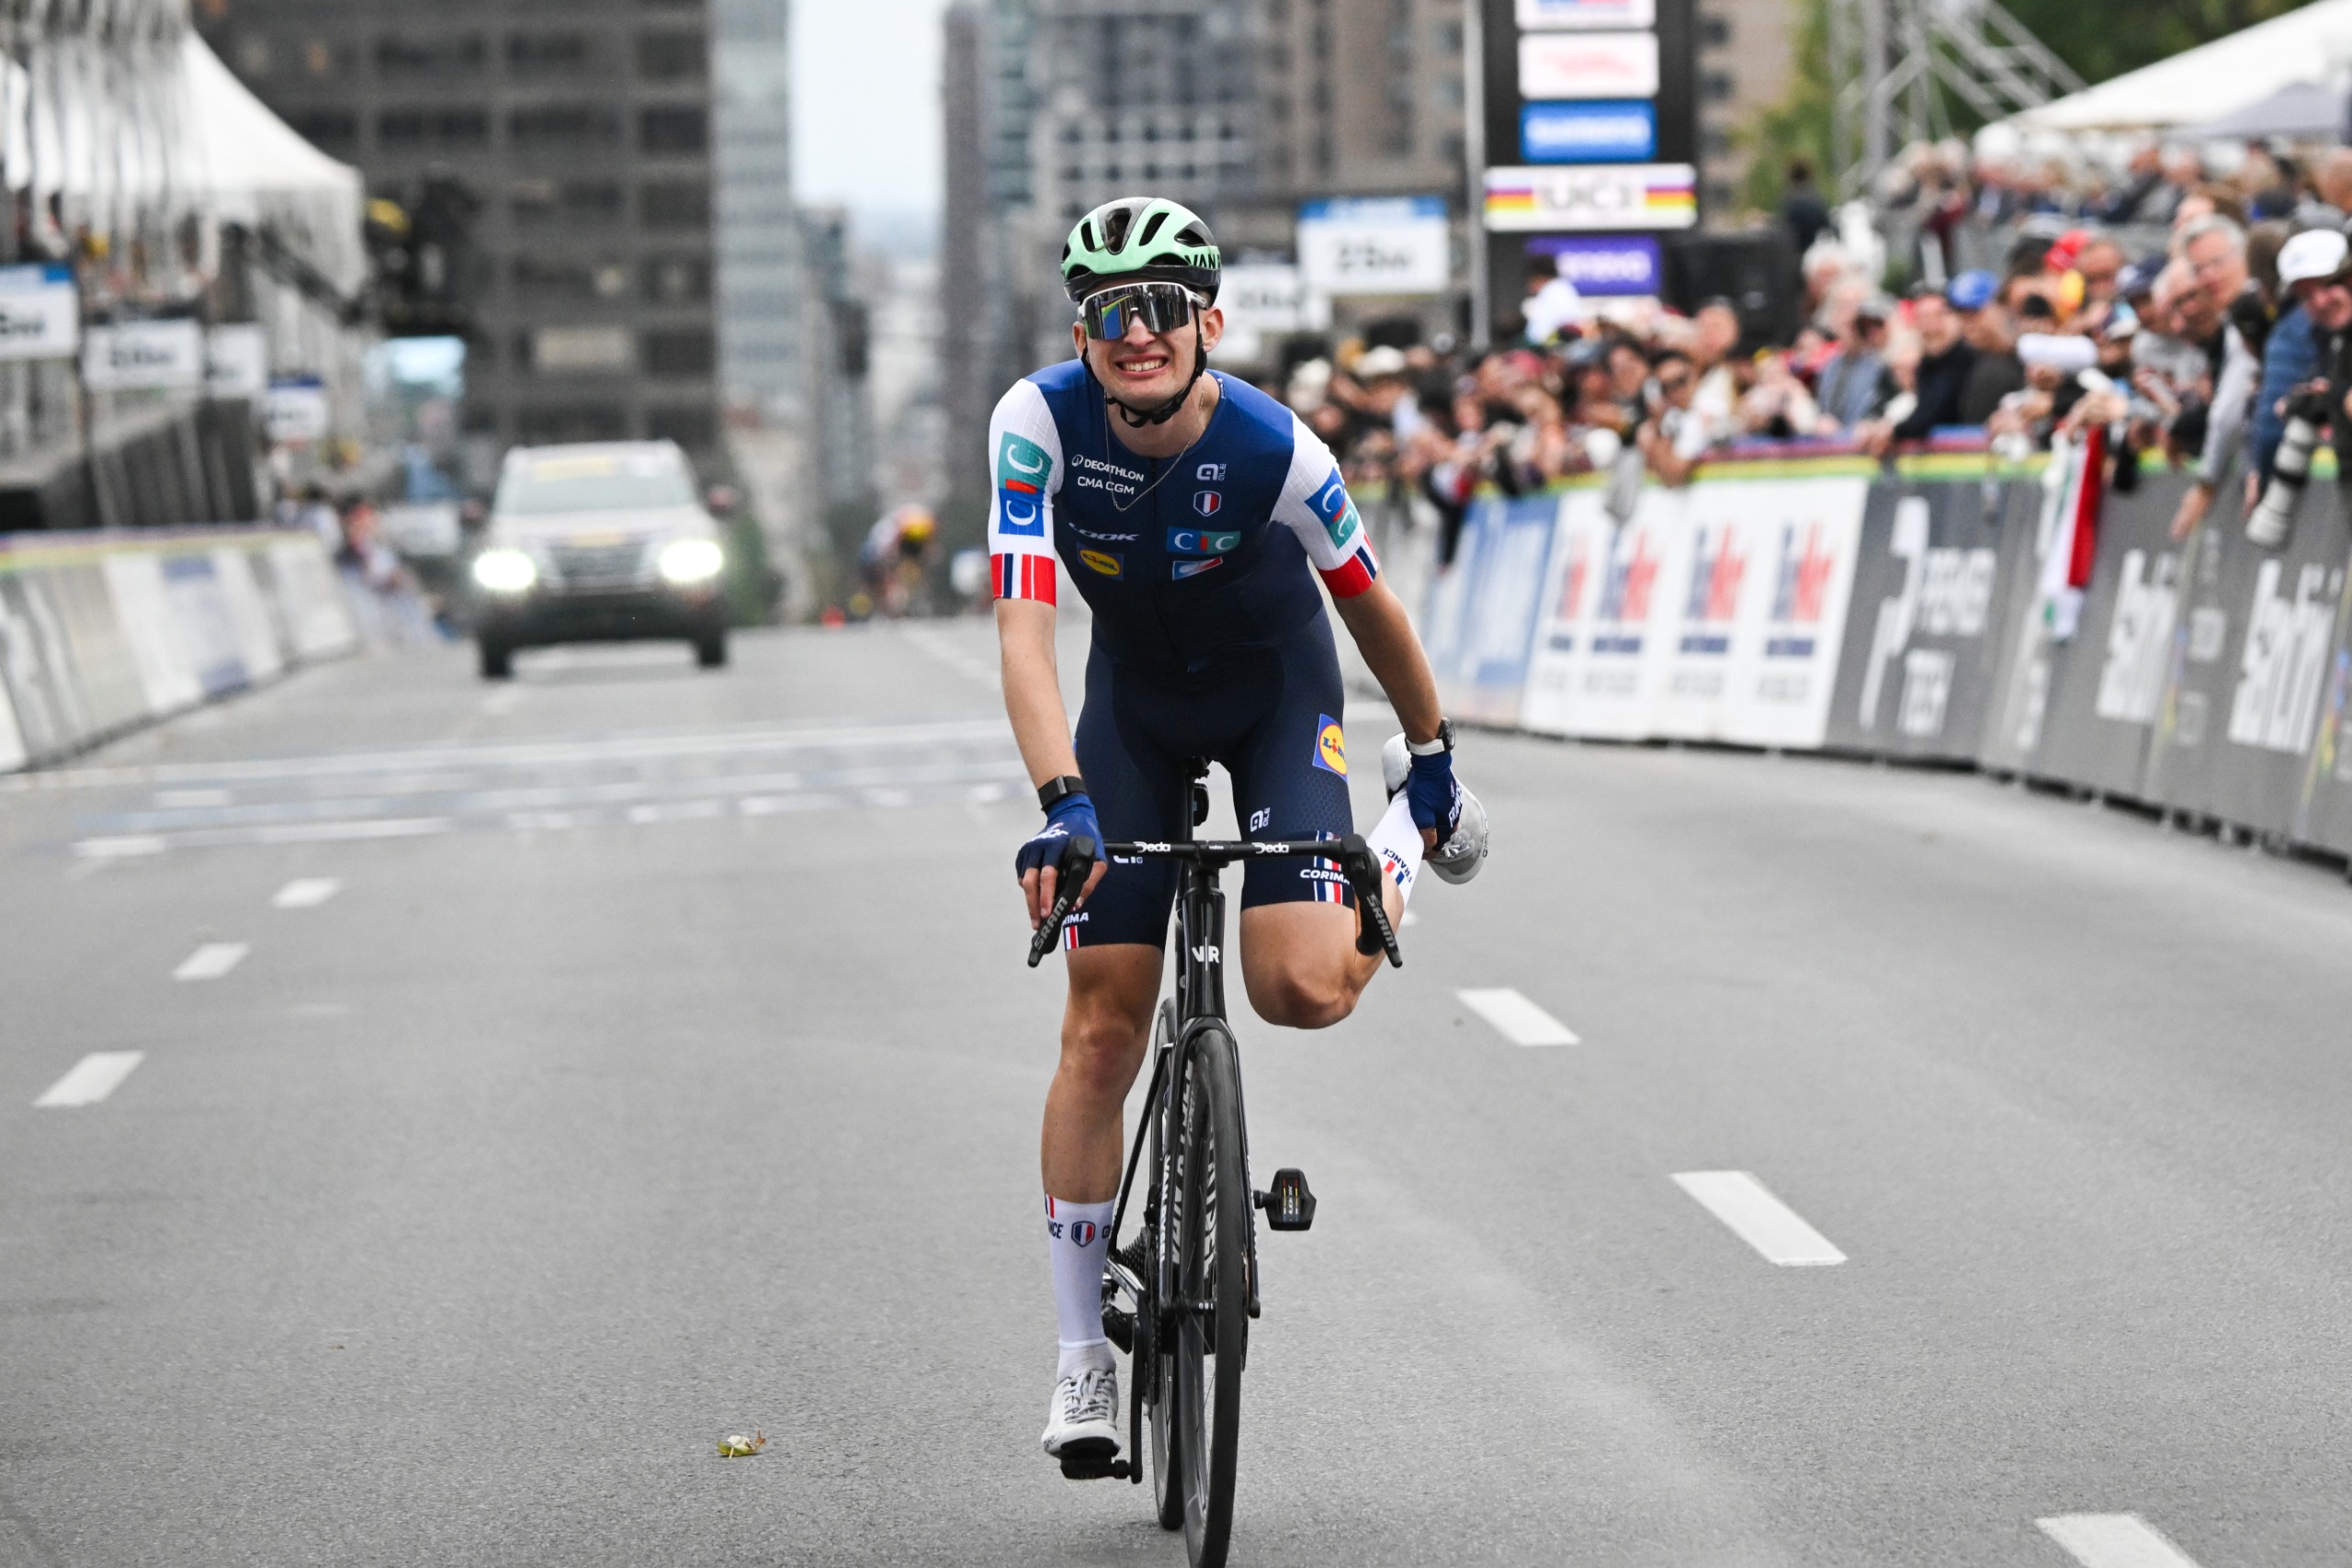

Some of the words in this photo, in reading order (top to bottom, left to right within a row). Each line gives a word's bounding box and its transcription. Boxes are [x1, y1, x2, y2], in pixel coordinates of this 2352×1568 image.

[1084, 458, 1145, 482] DECATHLON
[1077, 476, 1103, 490] CMA
[1105, 480, 1136, 495] CGM
[1174, 532, 1235, 551] CIC
[1132, 840, 1171, 853] Deda
[1251, 841, 1290, 854] Deda
[1381, 846, 1413, 884] FRANCE
[1034, 897, 1069, 951] SRAM
[1366, 892, 1396, 948] SRAM
